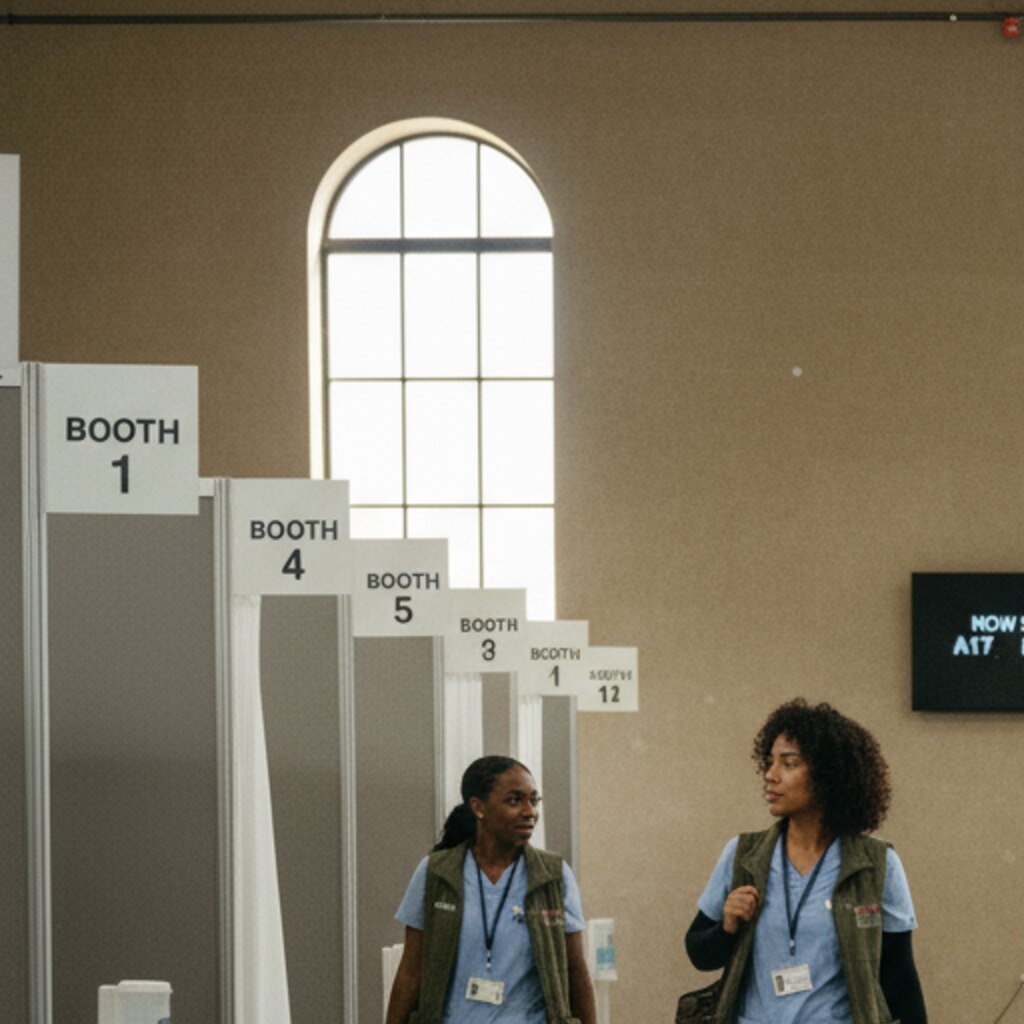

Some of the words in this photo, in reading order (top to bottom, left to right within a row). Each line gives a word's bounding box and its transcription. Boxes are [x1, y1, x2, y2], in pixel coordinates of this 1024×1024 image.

[66, 416, 179, 445] BOOTH
[111, 454, 129, 494] 1
[250, 519, 338, 541] BOOTH
[281, 548, 306, 581] 4
[367, 572, 440, 590] BOOTH
[394, 596, 414, 625] 5
[460, 617, 519, 633] BOOTH
[481, 638, 496, 662] 3
[952, 635, 995, 656] A17
[598, 684, 620, 704] 12
